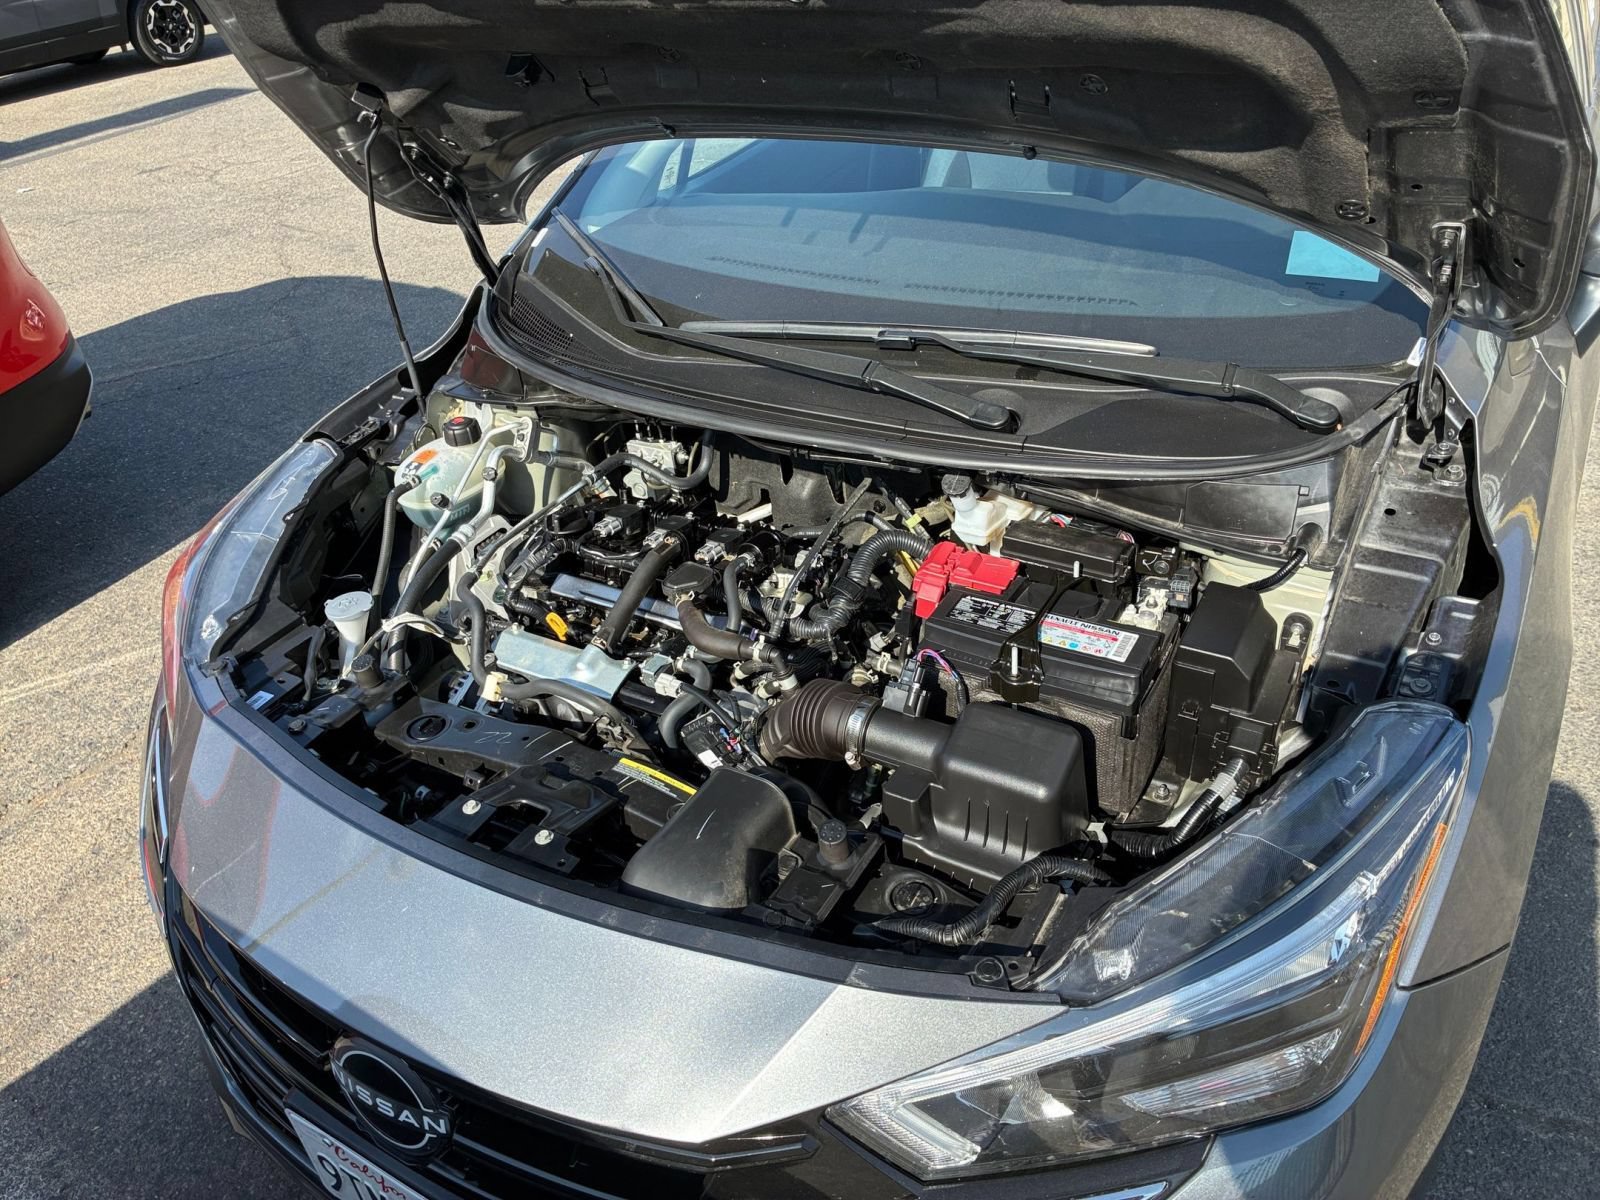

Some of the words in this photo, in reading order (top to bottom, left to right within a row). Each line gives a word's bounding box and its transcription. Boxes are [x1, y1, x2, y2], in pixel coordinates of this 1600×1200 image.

[1044, 613, 1079, 626] RENAULT
[1080, 622, 1120, 636] NISSAN
[331, 1060, 447, 1134] NISSAN
